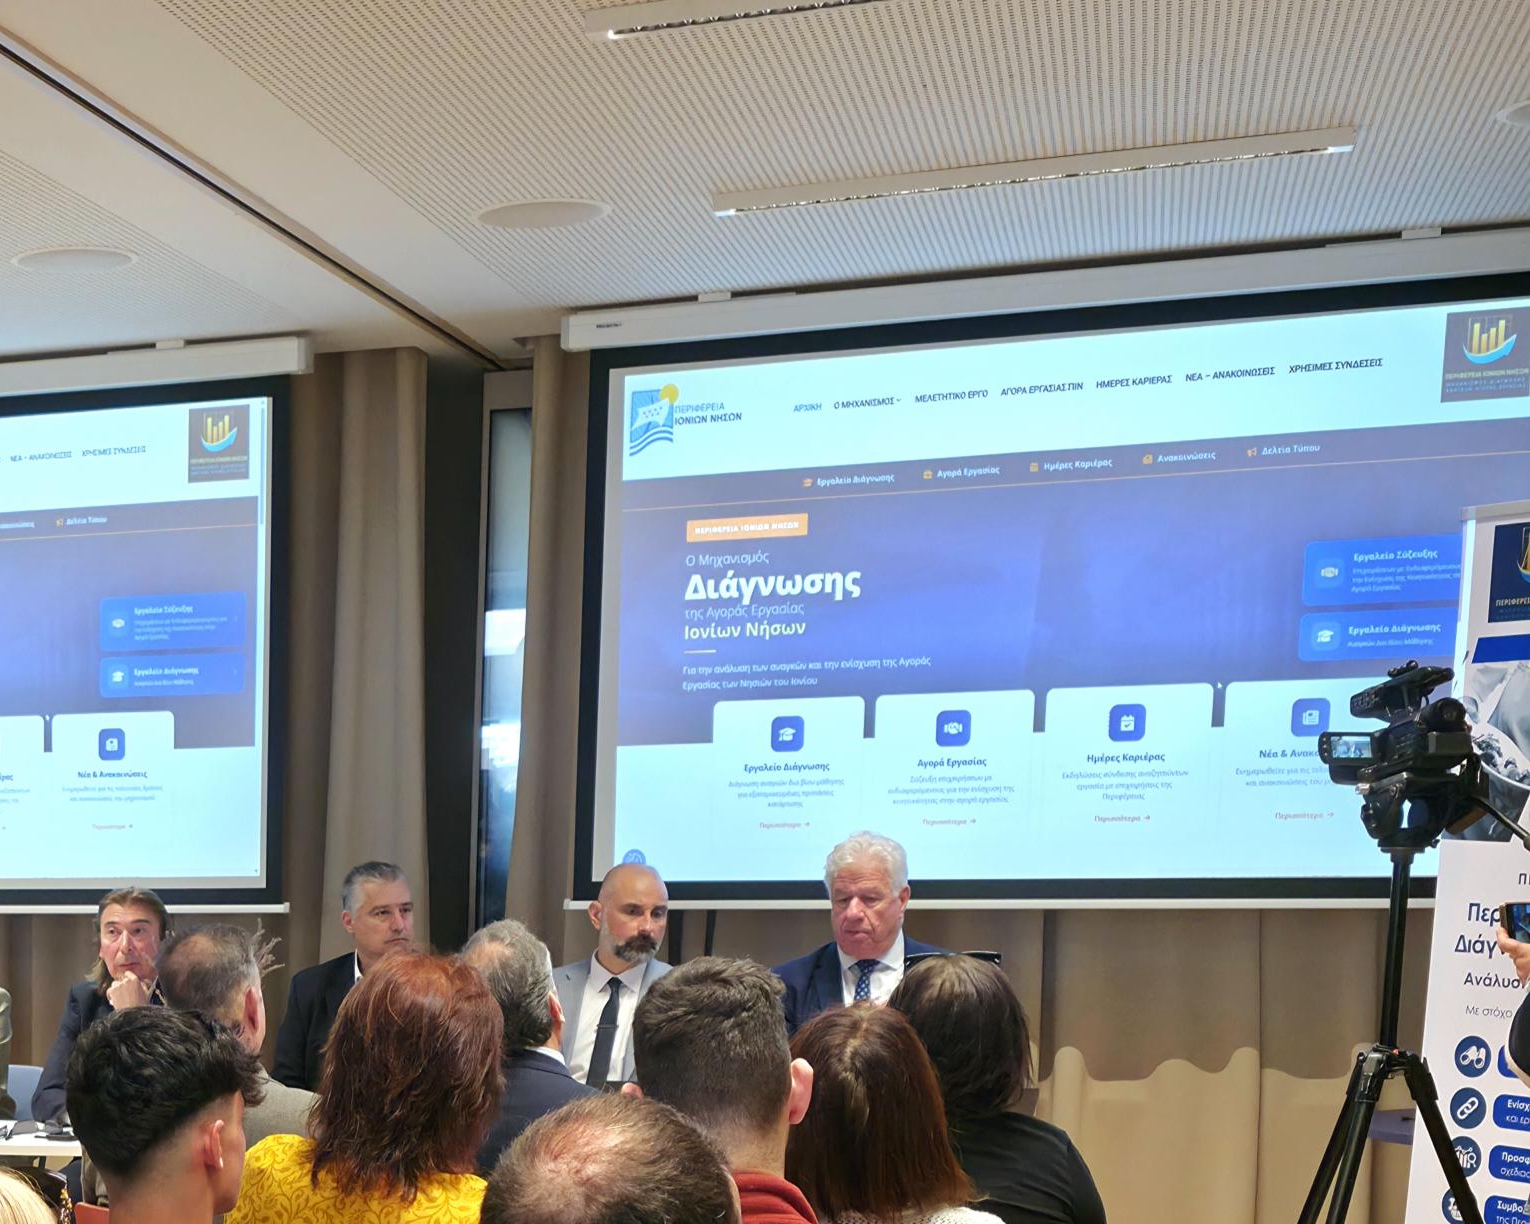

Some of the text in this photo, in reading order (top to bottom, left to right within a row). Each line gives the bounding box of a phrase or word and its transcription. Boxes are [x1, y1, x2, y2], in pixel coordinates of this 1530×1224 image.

[841, 397, 895, 409] ΜΗΧΑΝΙΣΜΟΣ
[967, 389, 988, 399] ΕΡΓΟ
[1000, 386, 1028, 397] ΑΓΟΡΑ
[1028, 383, 1067, 394] ΕΡΓΑΣΙΑΣ
[1096, 378, 1131, 389] ΗΜΕΡΕΣ
[1131, 374, 1172, 386] ΚΑΡΙΕΡΑΣ
[1185, 373, 1203, 382] ΝΕΑ
[1212, 366, 1275, 379] ΑΝΑΚΟΙΝΩΣΕΙΣ
[1289, 362, 1333, 374] ΧΡΗΣΙΜΕΣ
[1335, 358, 1383, 370] ΣΥΝΔΕΣΕΙΣ
[674, 402, 725, 414] ΠΕΡΙΦΕΡΕΙΑ
[674, 412, 743, 426] ΙΟΝΙΩΝ ΝΗΣΩΝ
[686, 550, 770, 568] Ο Μηχανισμός
[684, 569, 862, 605] Διάγνωσης
[685, 602, 805, 620] της Αγοράς Εργασίας
[684, 620, 807, 641] Ιονίων Νήσων
[682, 665, 697, 675] Για
[698, 666, 713, 676] την
[713, 663, 751, 674] ανάλυση
[824, 660, 840, 671] την
[840, 658, 881, 670] ενίσχυση
[882, 658, 898, 668] της
[898, 655, 932, 668] Αγοράς
[682, 680, 721, 692] Εργασίας
[773, 678, 790, 687] του
[1087, 752, 1166, 765] Ημέρες Καριέρας
[1259, 749, 1278, 759] Νέα
[1280, 749, 1288, 759] &
[744, 762, 830, 774] Εργαλείο Διάγνωσης
[917, 757, 988, 769] Αγορά Εργασίας
[1518, 873, 1530, 886] Π
[1454, 933, 1506, 959] Διάγ
[1463, 971, 1525, 989] Ανάλυσ
[1465, 1004, 1513, 1019] Με στόχο
